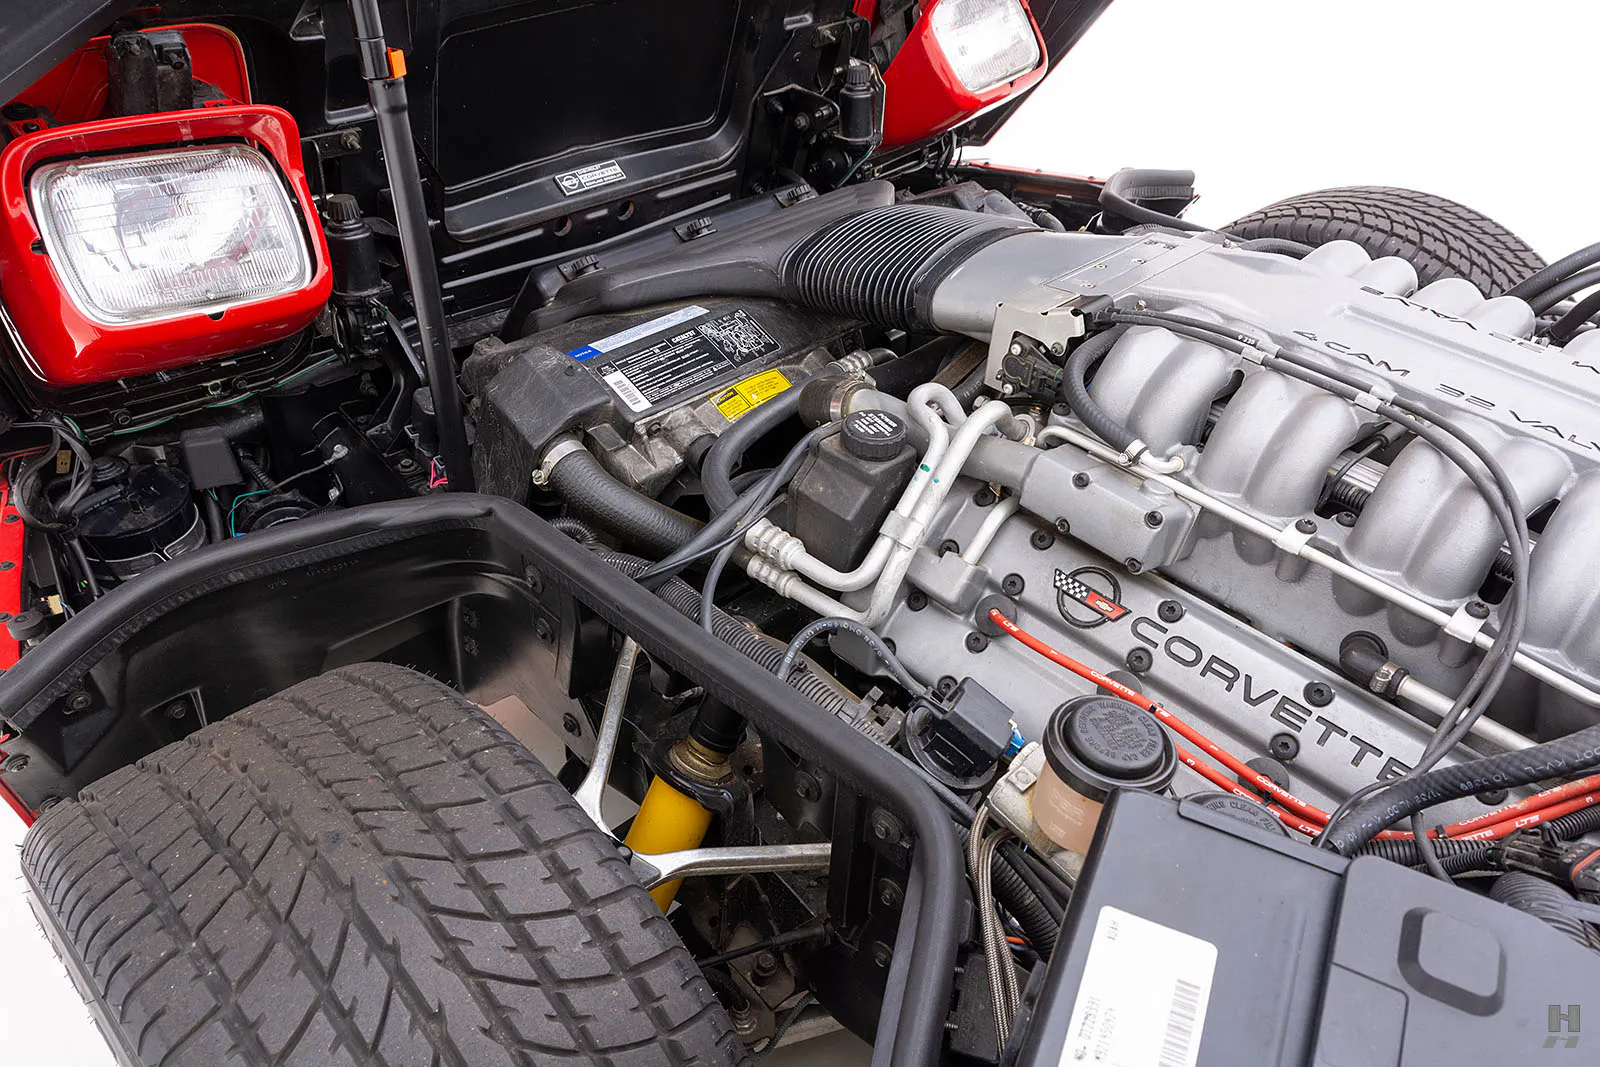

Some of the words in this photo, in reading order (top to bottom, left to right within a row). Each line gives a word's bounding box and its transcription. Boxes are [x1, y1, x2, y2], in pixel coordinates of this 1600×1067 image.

[582, 166, 619, 181] CORVETTE
[1293, 329, 1318, 342] 4
[1324, 341, 1410, 377] CAM
[1436, 383, 1495, 411] 32
[1089, 669, 1136, 697] CORVETTE
[1255, 774, 1307, 807] CORVETTE
[1130, 616, 1417, 785] CORVETTE
[1514, 814, 1540, 827] LT5
